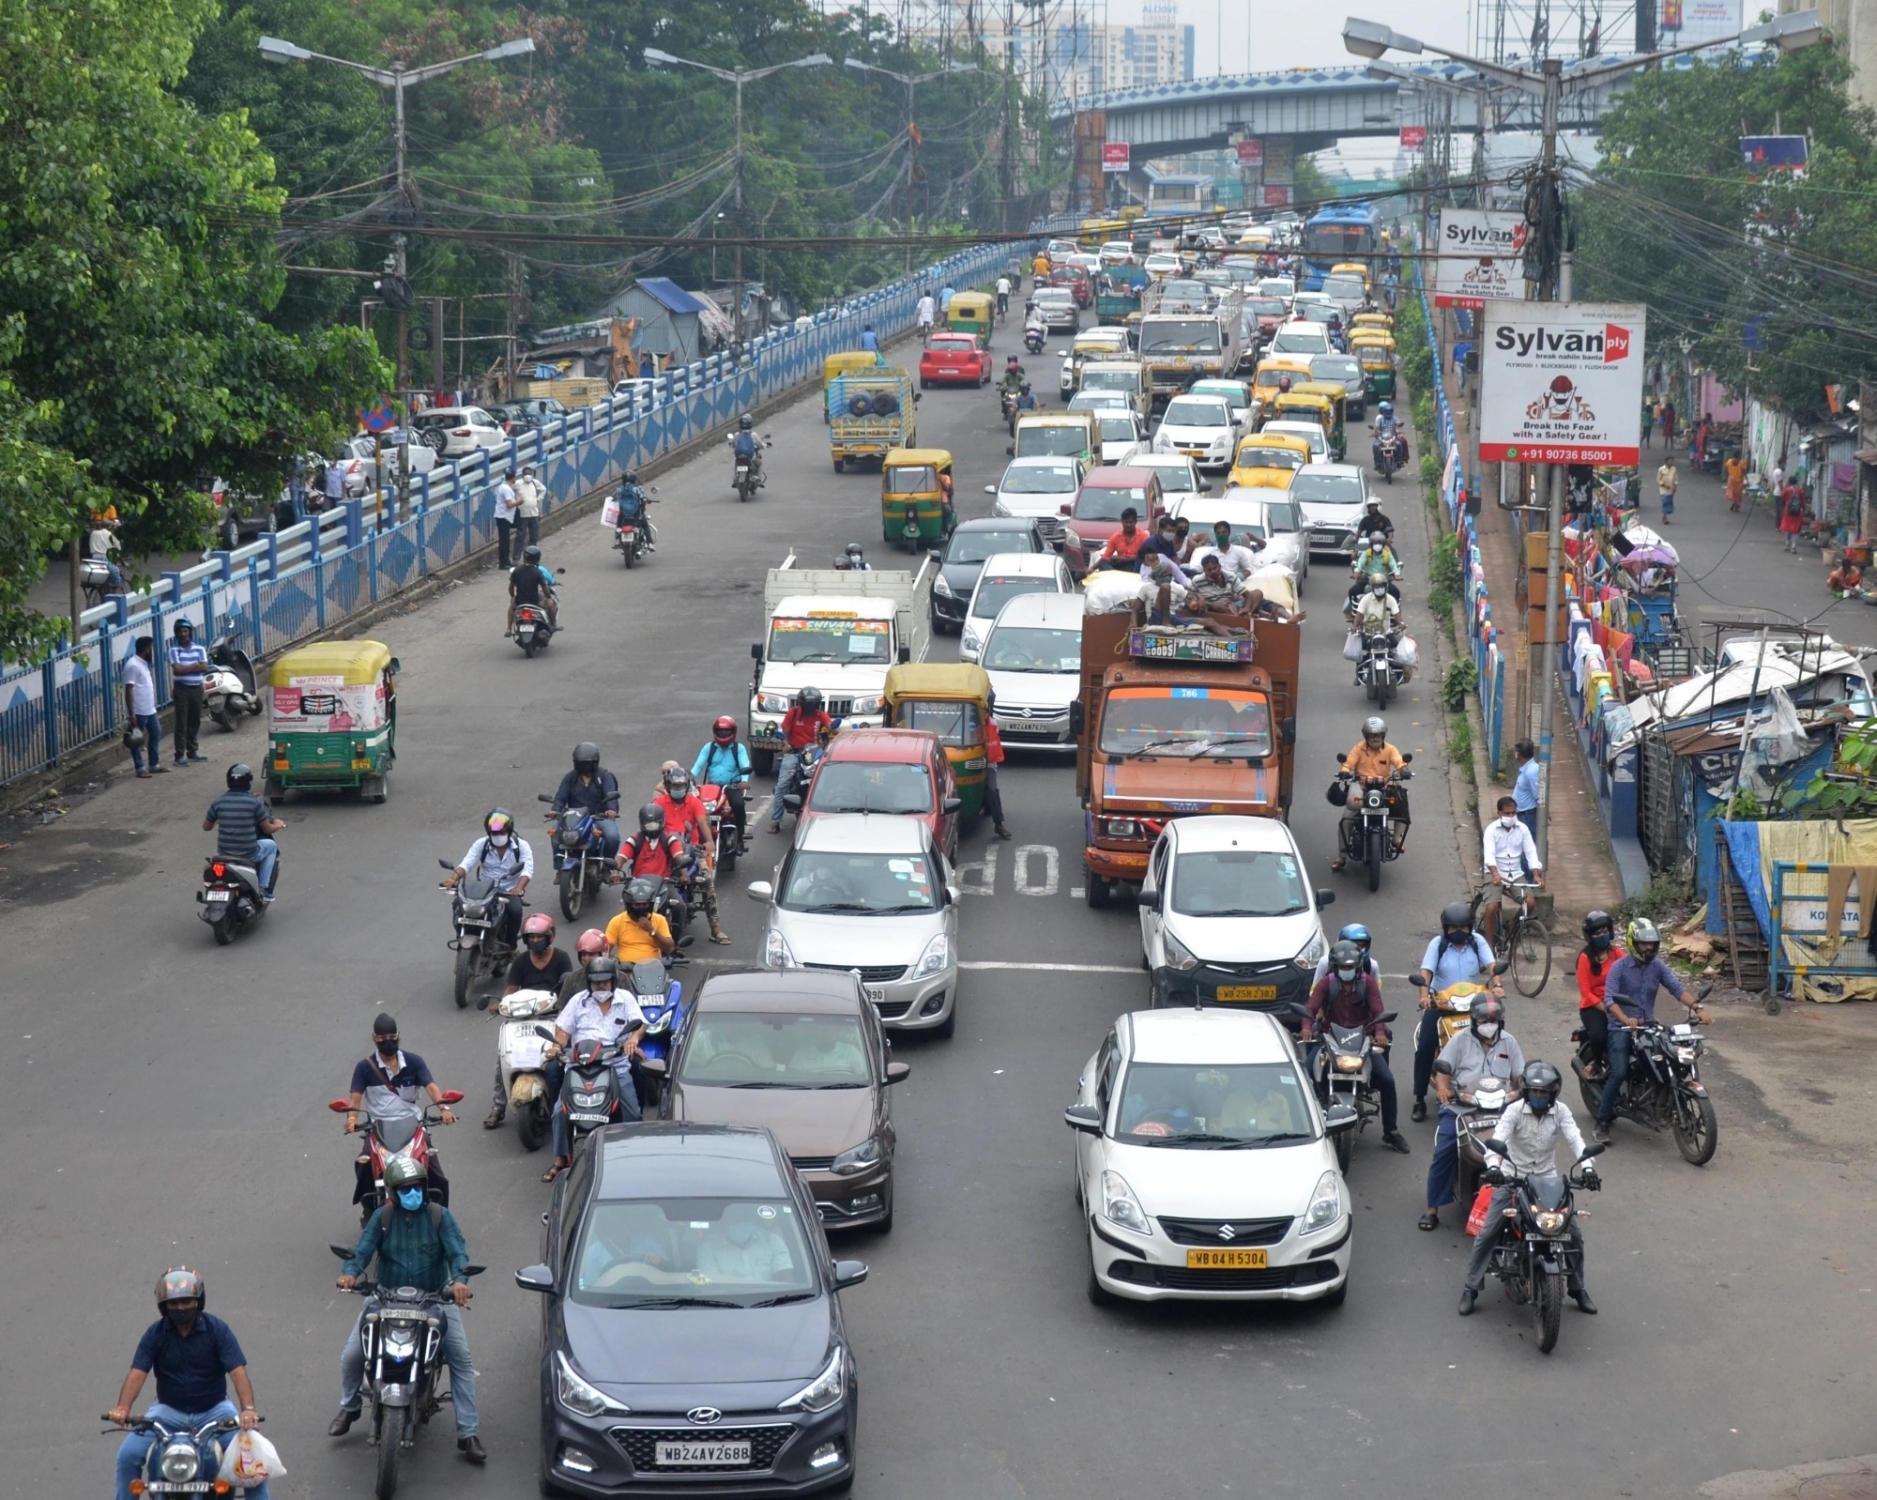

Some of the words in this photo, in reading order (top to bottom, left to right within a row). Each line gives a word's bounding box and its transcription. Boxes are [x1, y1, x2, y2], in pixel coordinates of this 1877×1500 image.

[1582, 312, 1637, 320] www.sylvanply.com
[1607, 337, 1628, 350] ply
[1524, 422, 1551, 430] Break
[1554, 422, 1570, 430] the
[1573, 423, 1595, 431] Fear
[1513, 431, 1533, 439] with
[1545, 431, 1576, 441] Safety
[1522, 449, 1542, 459] +91
[1546, 450, 1578, 460] 90736
[1581, 451, 1613, 461] 85001
[1146, 644, 1174, 657] GOODS
[307, 676, 338, 684] PRINCE
[1181, 688, 1198, 698] 786
[1810, 911, 1860, 921] KOATA
[1196, 1252, 1210, 1264] WB
[1212, 1252, 1225, 1264] 04
[1228, 1252, 1235, 1264] H
[1237, 1252, 1264, 1264] 5304
[665, 1447, 750, 1461] WB24AV2688
